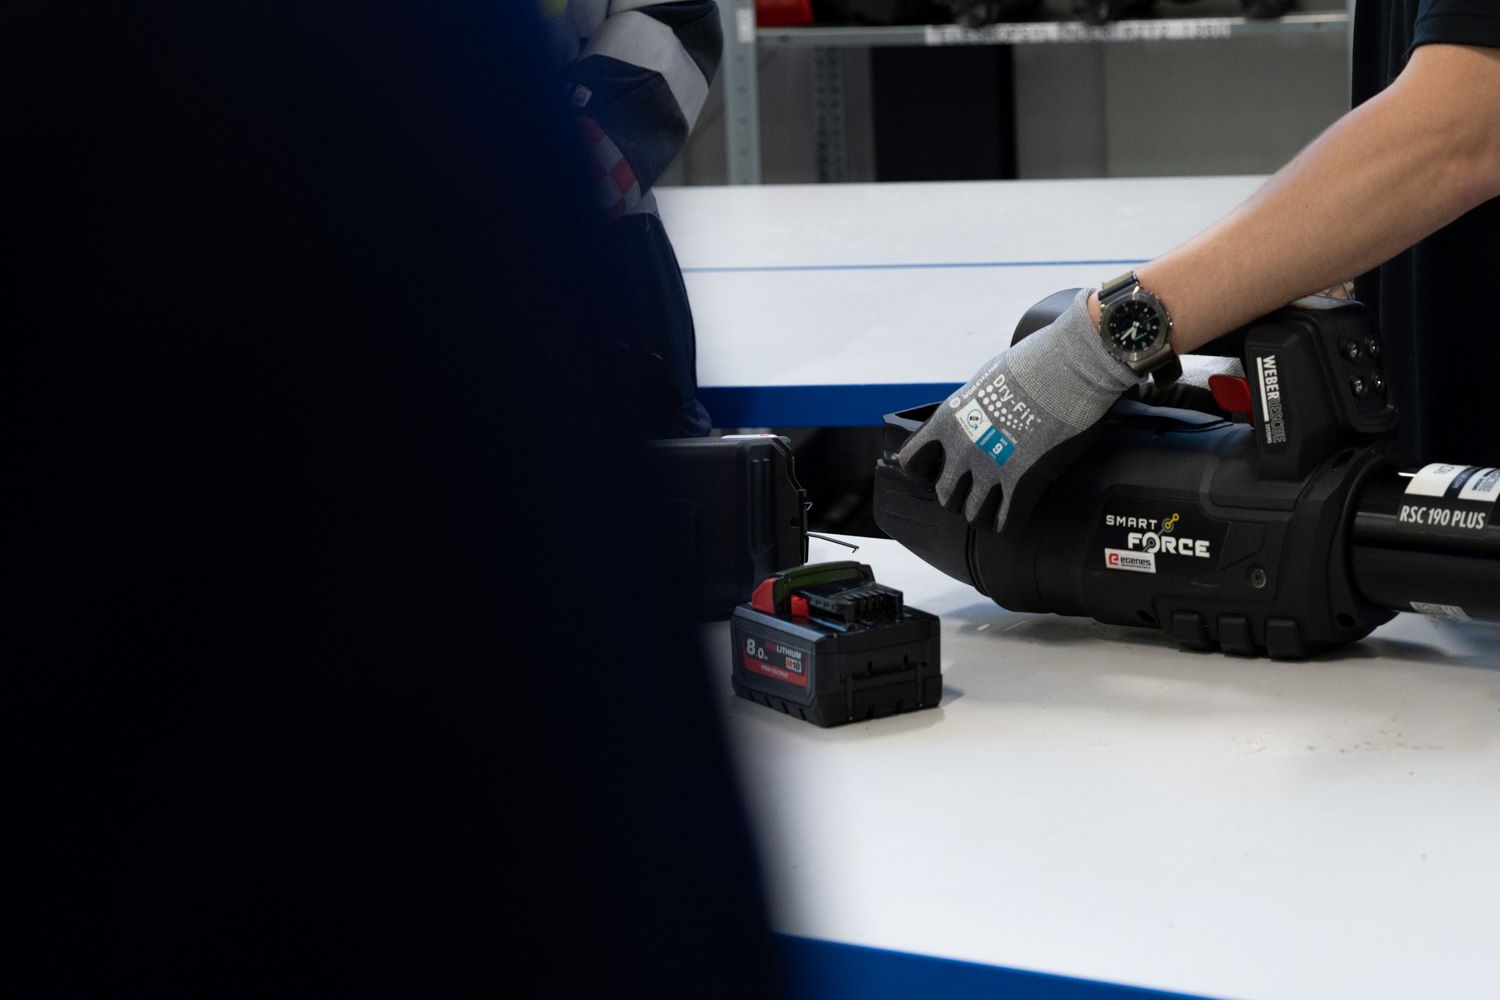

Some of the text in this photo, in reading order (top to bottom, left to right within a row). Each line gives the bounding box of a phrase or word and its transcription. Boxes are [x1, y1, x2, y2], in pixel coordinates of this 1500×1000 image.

[1263, 355, 1280, 400] WEBER
[1106, 515, 1157, 530] SMART
[1399, 505, 1486, 529] RSC 190 PLUS
[1128, 532, 1210, 558] FORCE
